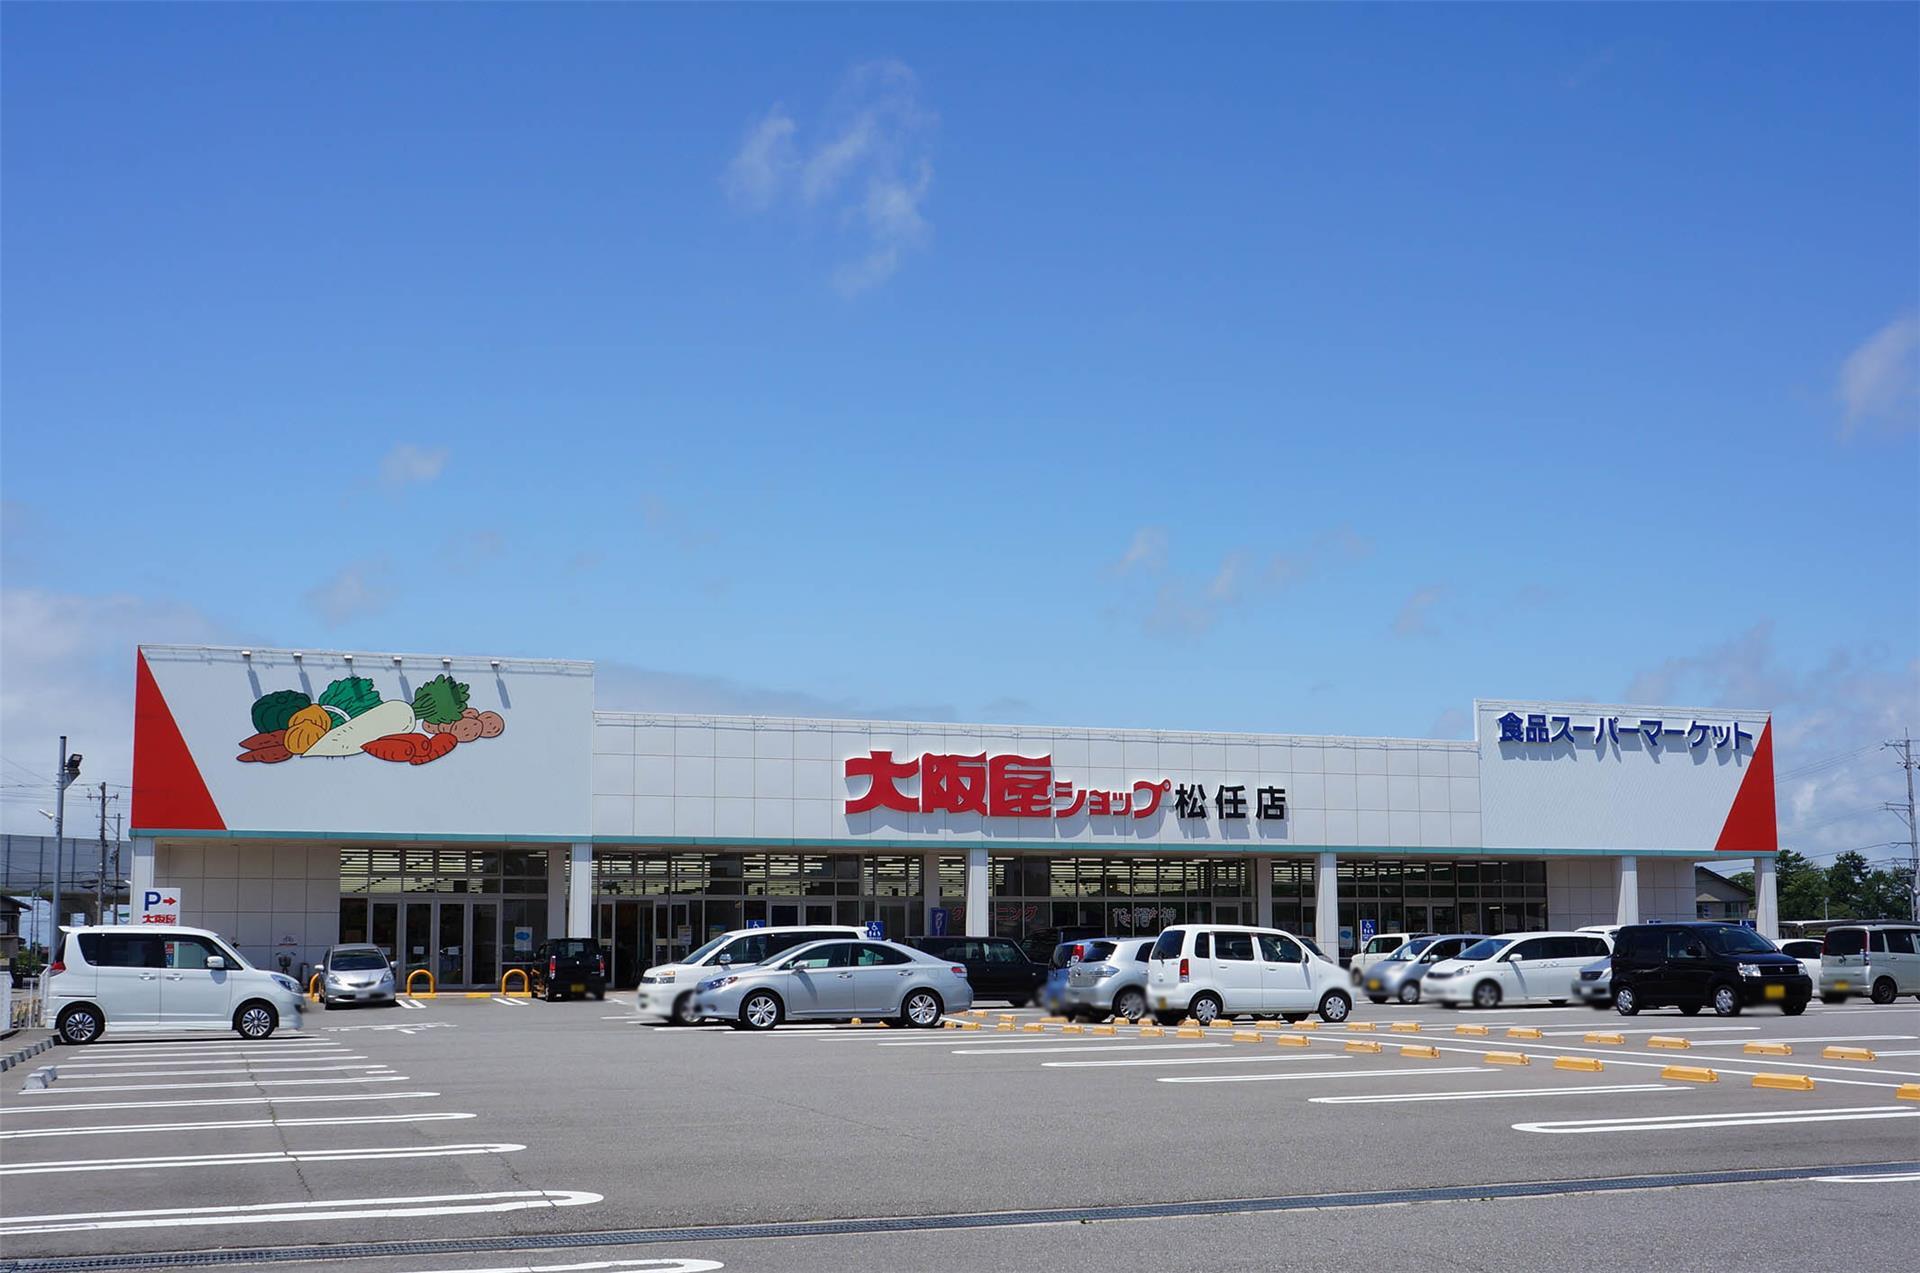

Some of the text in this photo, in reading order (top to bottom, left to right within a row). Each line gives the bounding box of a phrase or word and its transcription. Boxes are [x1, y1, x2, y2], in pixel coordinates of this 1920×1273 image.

[1498, 711, 1753, 750] 食品スーパーマーケット
[144, 891, 162, 911] P
